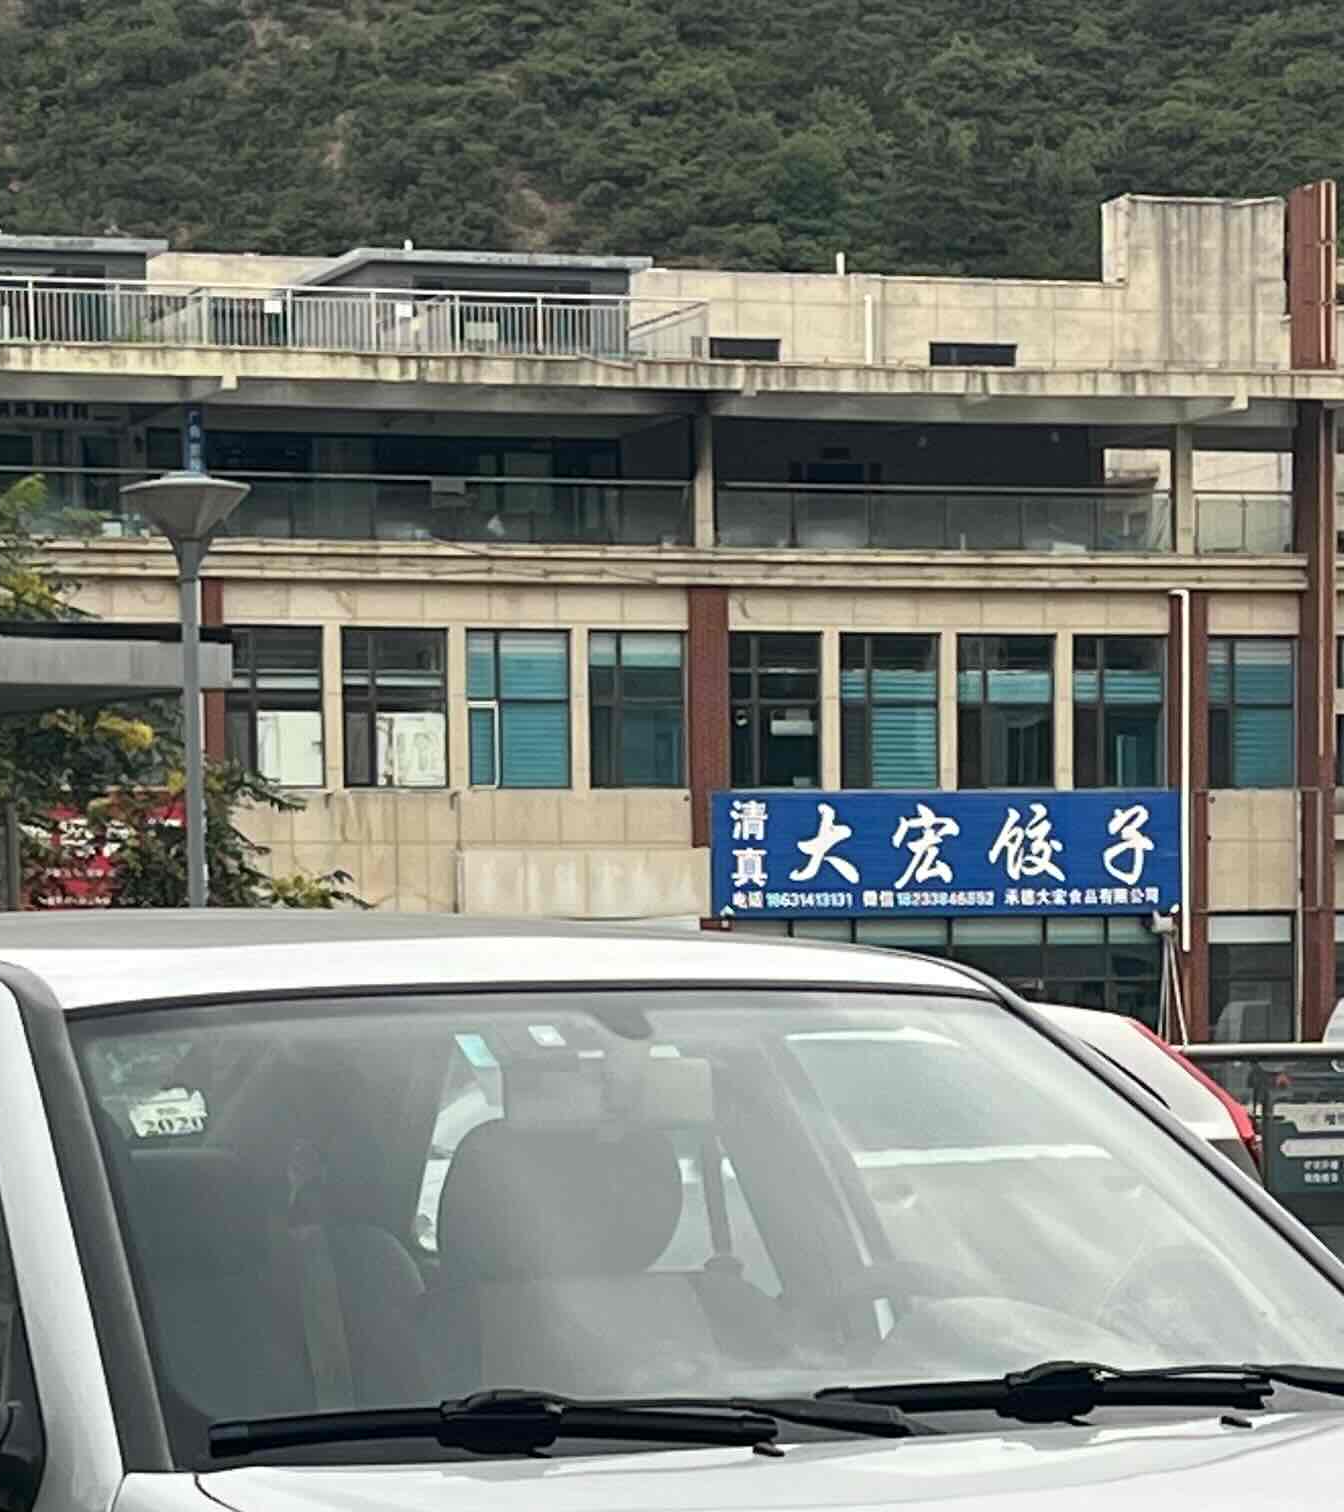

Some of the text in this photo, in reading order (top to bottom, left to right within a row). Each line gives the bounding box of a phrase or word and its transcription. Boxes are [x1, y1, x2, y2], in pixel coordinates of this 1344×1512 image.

[729, 799, 768, 888] 清真
[788, 802, 1156, 889] 大宏饺子
